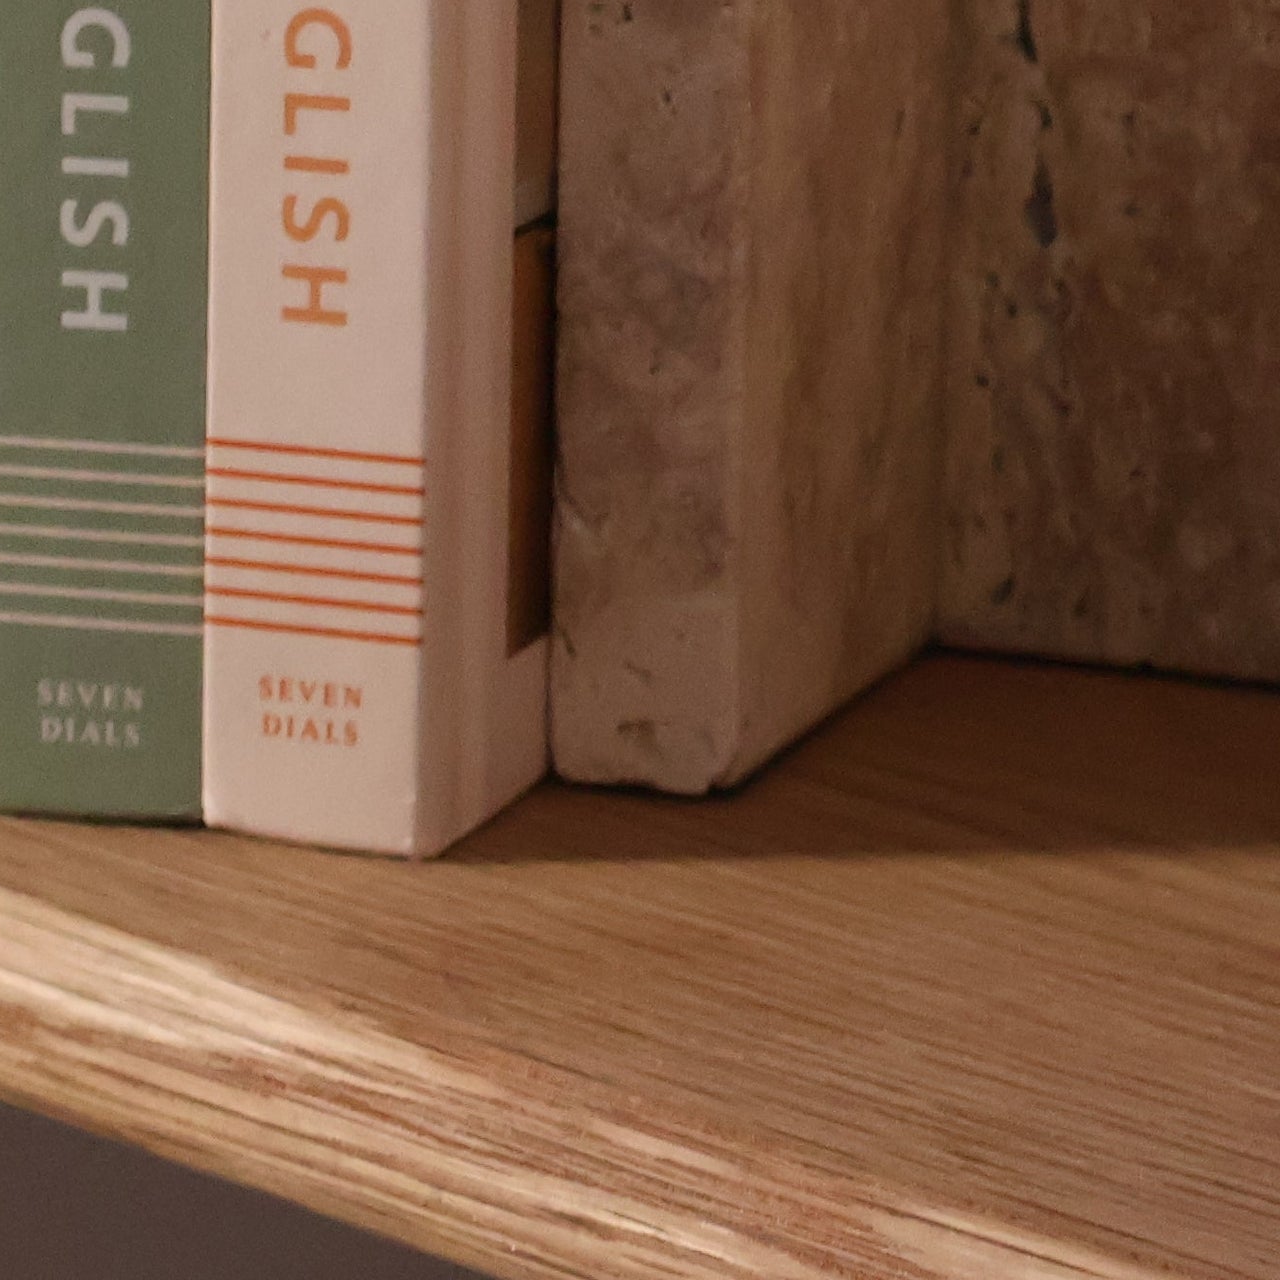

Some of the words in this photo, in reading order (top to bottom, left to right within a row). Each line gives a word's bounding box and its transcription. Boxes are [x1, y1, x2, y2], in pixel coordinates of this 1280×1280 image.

[37, 679, 142, 711] SEVEN
[258, 675, 362, 709] SEVEN
[41, 714, 139, 746] DIALS
[262, 713, 358, 747] DIALS
